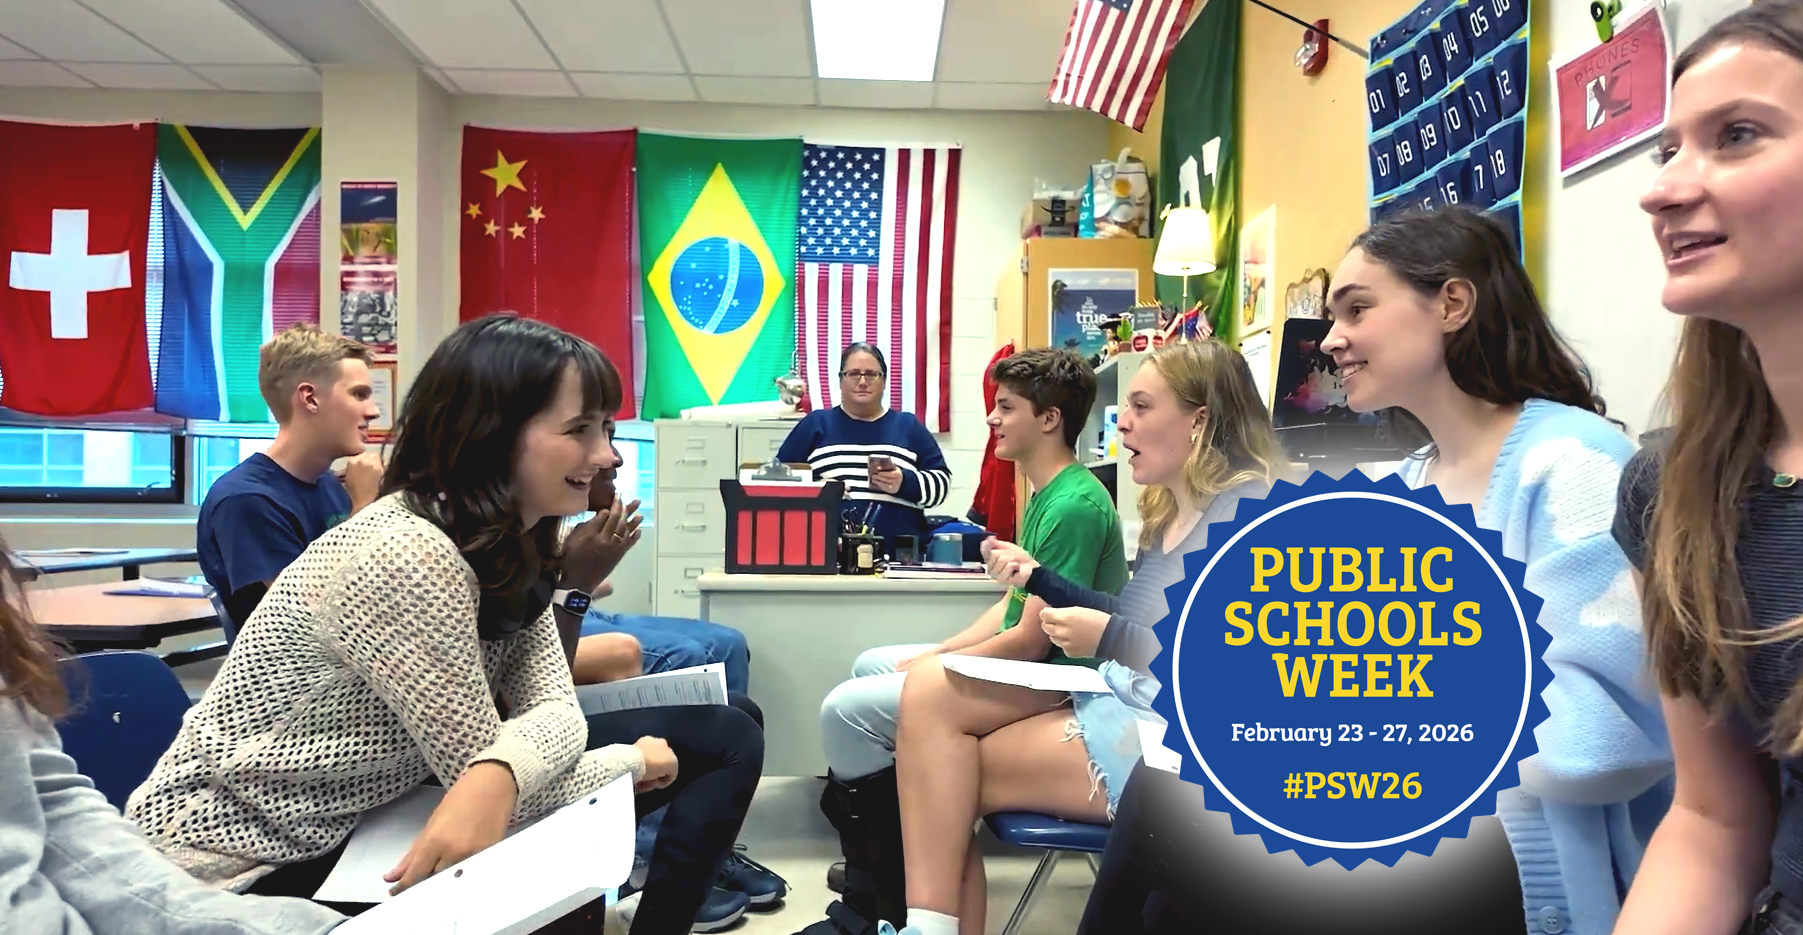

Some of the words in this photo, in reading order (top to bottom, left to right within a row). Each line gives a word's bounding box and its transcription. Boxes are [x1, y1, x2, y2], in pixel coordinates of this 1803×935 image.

[1369, 88, 1386, 113] 01
[1395, 71, 1410, 97] 02
[1419, 54, 1433, 81] 03
[1442, 32, 1459, 61] 04
[1469, 5, 1490, 38] 05
[1574, 37, 1640, 87] PHONES
[1376, 153, 1391, 177] 07
[1396, 140, 1413, 166] 08
[1420, 123, 1437, 150] 09
[1443, 106, 1461, 133] 10
[1468, 91, 1487, 117] 11
[1496, 69, 1512, 100] 12
[1440, 182, 1459, 207] 16
[1490, 149, 1506, 178] 18
[1075, 311, 1108, 325] true
